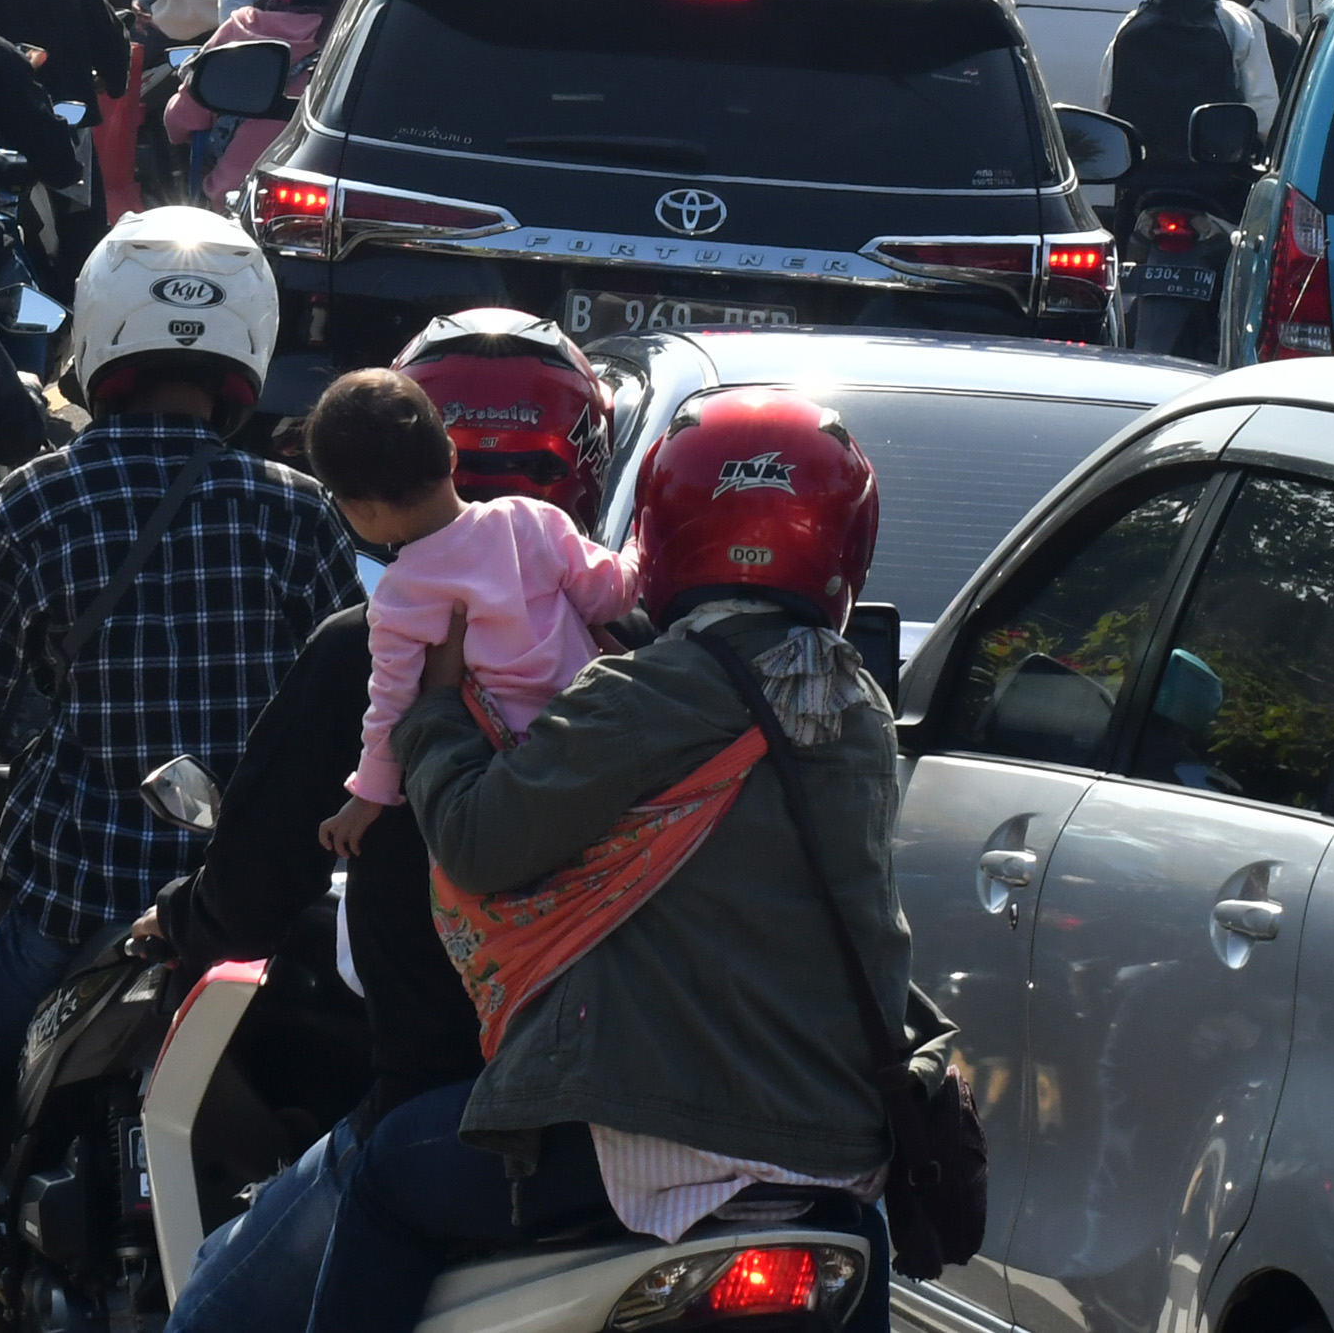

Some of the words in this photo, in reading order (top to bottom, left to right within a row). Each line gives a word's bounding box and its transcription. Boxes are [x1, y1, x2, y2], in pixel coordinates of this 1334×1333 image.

[525, 234, 851, 274] FORTUNER
[1144, 267, 1181, 280] 6304
[170, 282, 205, 301] Kyt
[571, 295, 592, 333] B
[173, 323, 200, 335] DOT
[443, 401, 540, 428] Predator
[480, 437, 498, 448] DOT
[718, 460, 797, 484] INK
[733, 548, 768, 563] DOT
